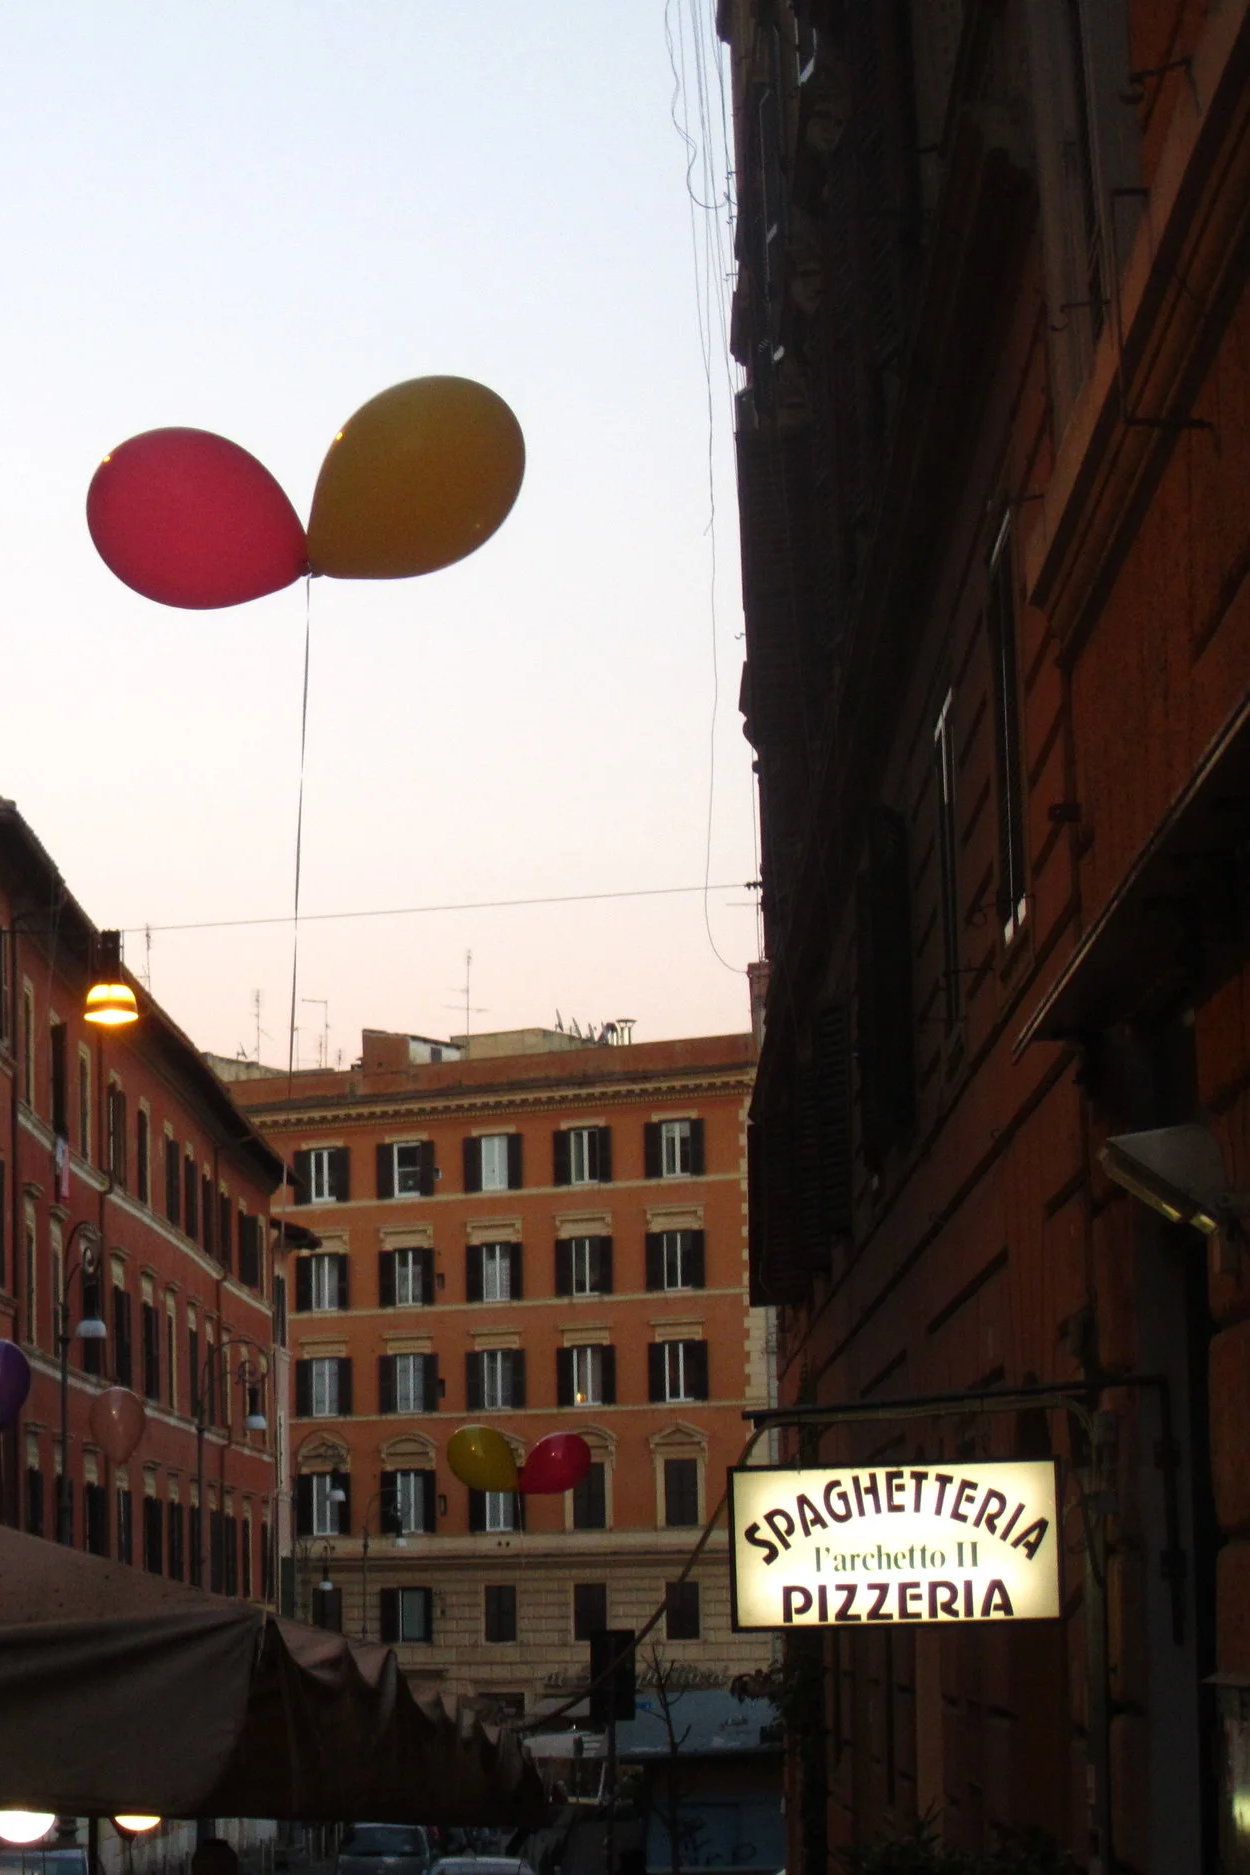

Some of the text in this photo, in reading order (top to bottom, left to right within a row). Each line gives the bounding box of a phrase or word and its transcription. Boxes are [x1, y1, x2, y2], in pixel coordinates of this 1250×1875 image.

[744, 1470, 1049, 1566] SPAGHETTERIA
[956, 1540, 979, 1569] II
[782, 1578, 1015, 1624] PIZZERIA
